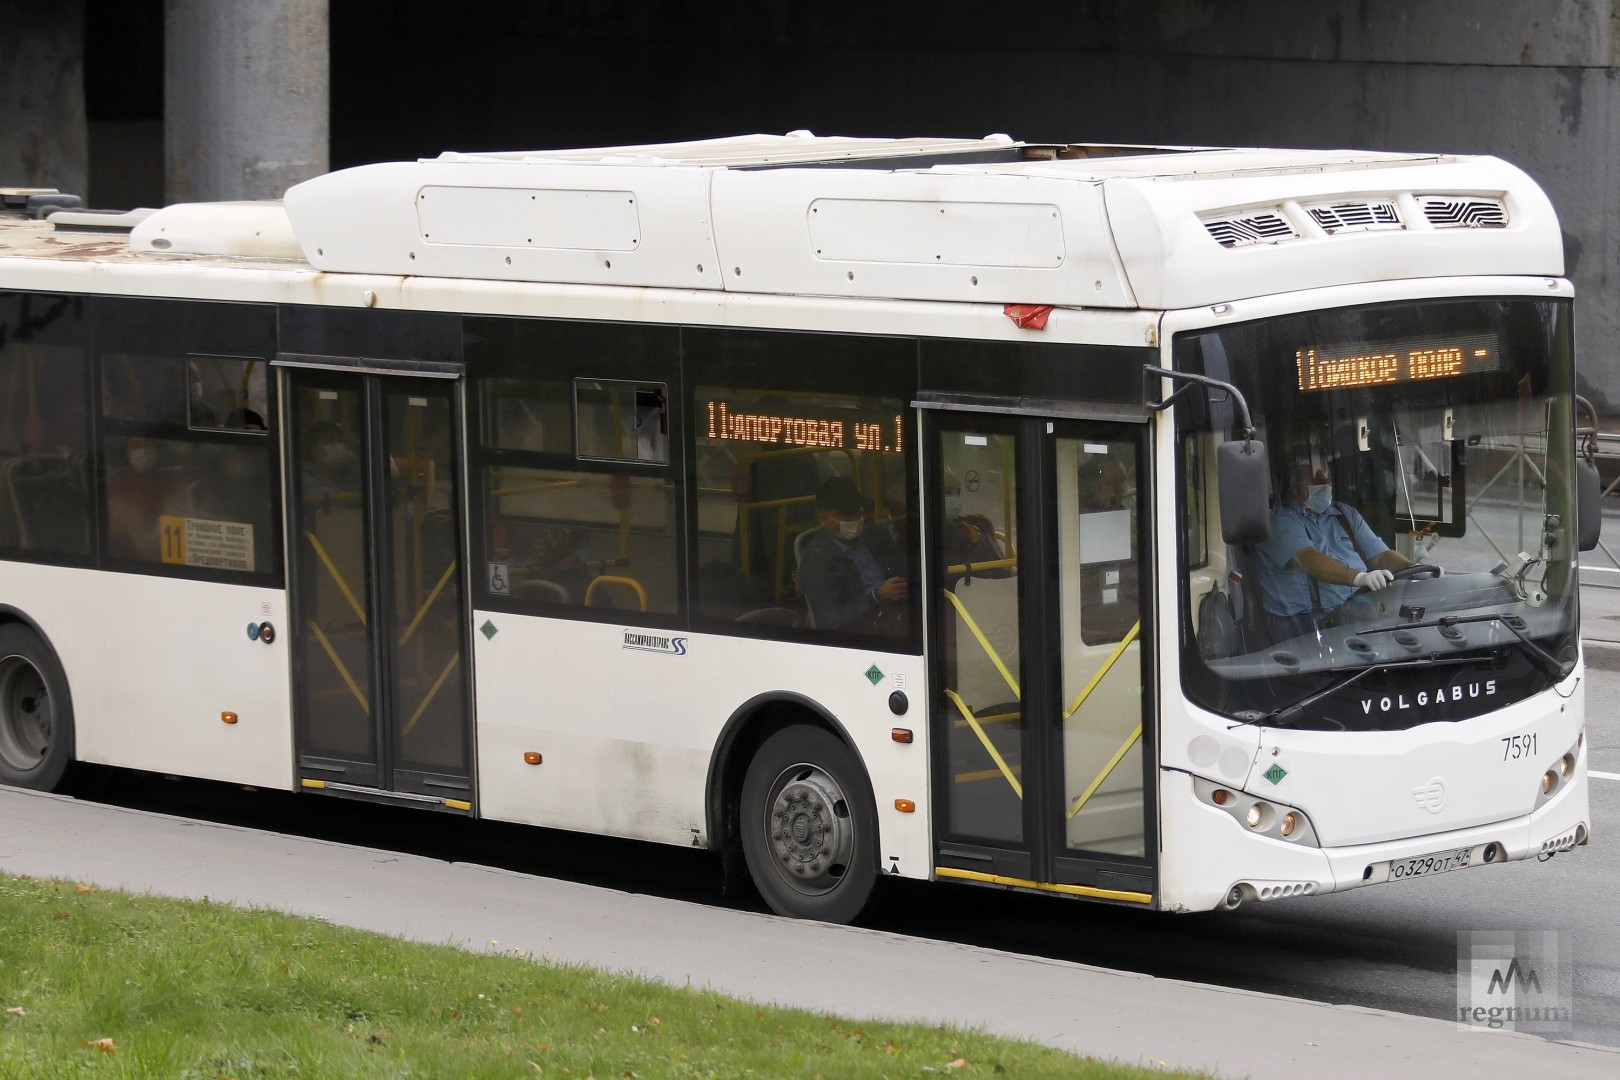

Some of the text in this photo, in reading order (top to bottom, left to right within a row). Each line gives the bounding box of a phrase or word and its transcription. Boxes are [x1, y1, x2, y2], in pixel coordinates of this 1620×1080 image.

[164, 525, 182, 559] 11
[867, 671, 881, 679] КПГ
[1361, 680, 1496, 714] VOLGABUS
[1501, 732, 1537, 761] 7591
[1266, 769, 1284, 780] КПГ
